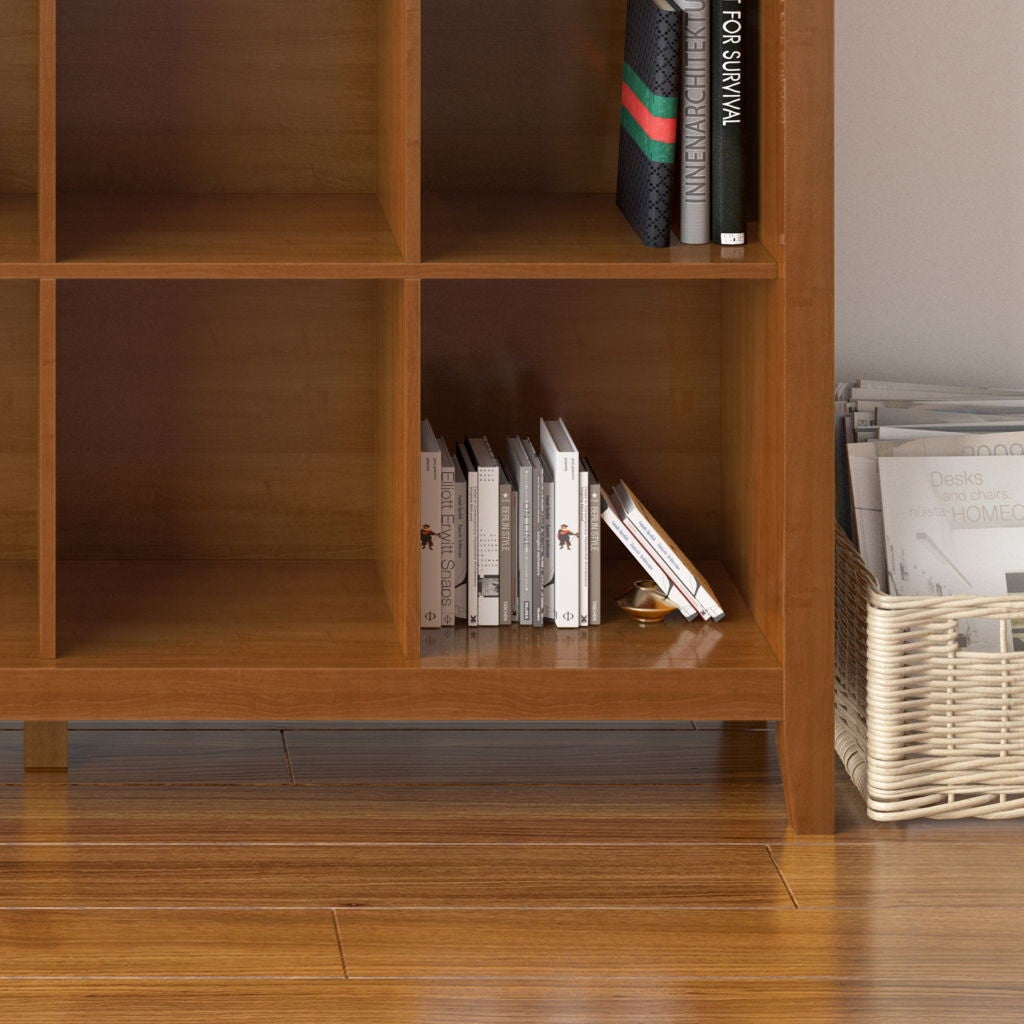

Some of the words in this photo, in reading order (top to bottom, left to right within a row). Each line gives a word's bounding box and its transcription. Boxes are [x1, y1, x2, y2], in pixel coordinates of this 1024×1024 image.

[722, 10, 742, 44] FOR
[722, 50, 742, 126] SURVIVAL
[441, 472, 454, 510] Elliott
[930, 470, 984, 488] Desks
[943, 490, 966, 502] and
[970, 488, 1013, 501] chairs.
[501, 506, 510, 530] BERLIN
[590, 506, 599, 530] BERLIN
[441, 514, 454, 554] Erwitt
[501, 531, 510, 552] STYLE
[590, 531, 599, 552] STYLE
[441, 559, 454, 606] Snaps
